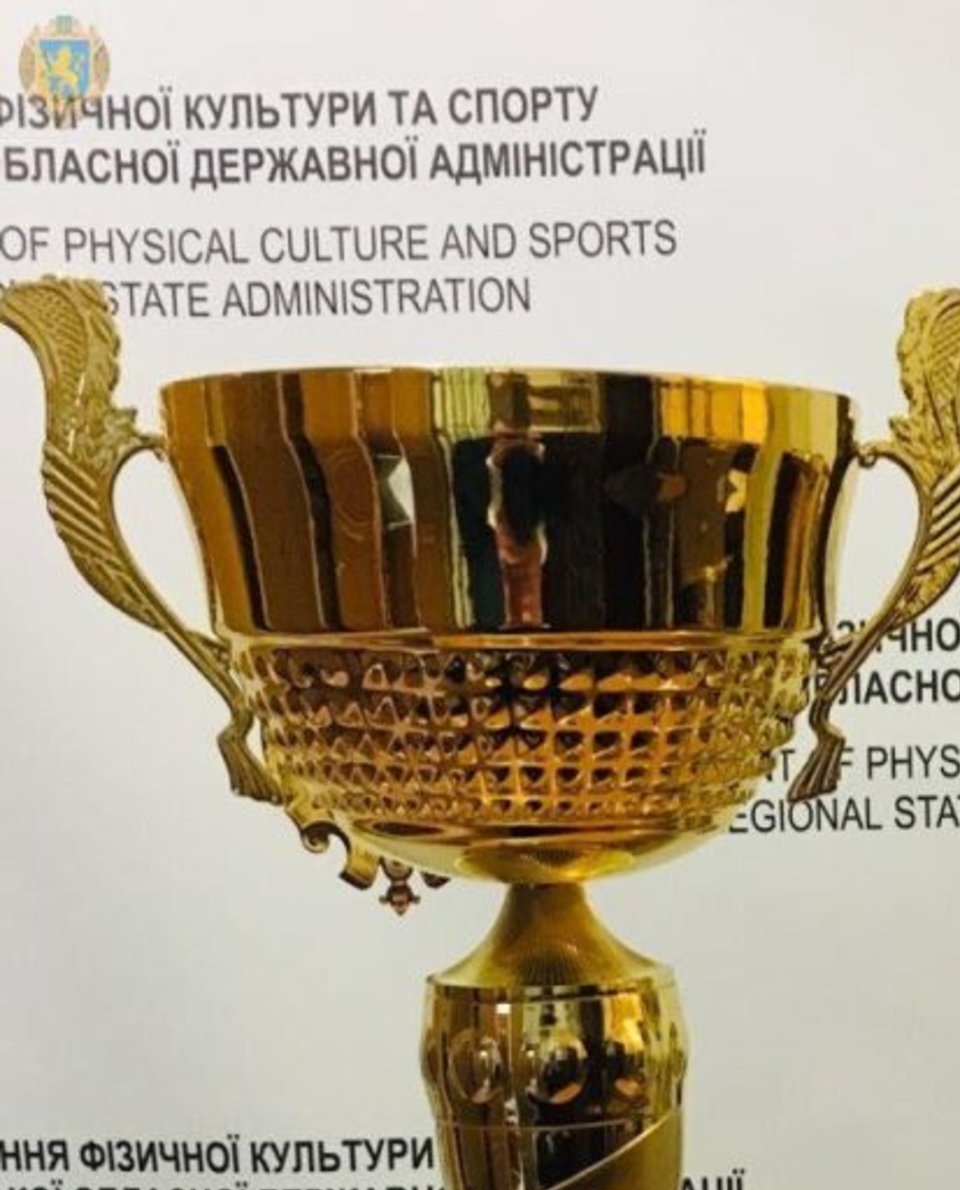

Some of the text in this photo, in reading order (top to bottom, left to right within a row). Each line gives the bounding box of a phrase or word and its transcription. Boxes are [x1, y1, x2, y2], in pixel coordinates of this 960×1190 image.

[184, 90, 376, 130] КУЛЬТУРИ
[389, 88, 436, 125] ТА
[448, 84, 600, 126] СПОРТУ
[190, 136, 418, 191] ДЕРЖАВНОЇ
[429, 130, 707, 184] АДМІНІСТРАЦІЇ
[0, 219, 678, 266] OF PHYSICAL CULTURE AND SPORTS
[222, 276, 532, 319] ADMINISTRATION
[79, 1133, 242, 1175] ФІЗИЧНОЇ
[250, 1136, 434, 1173] КУЛЬТУРИ
